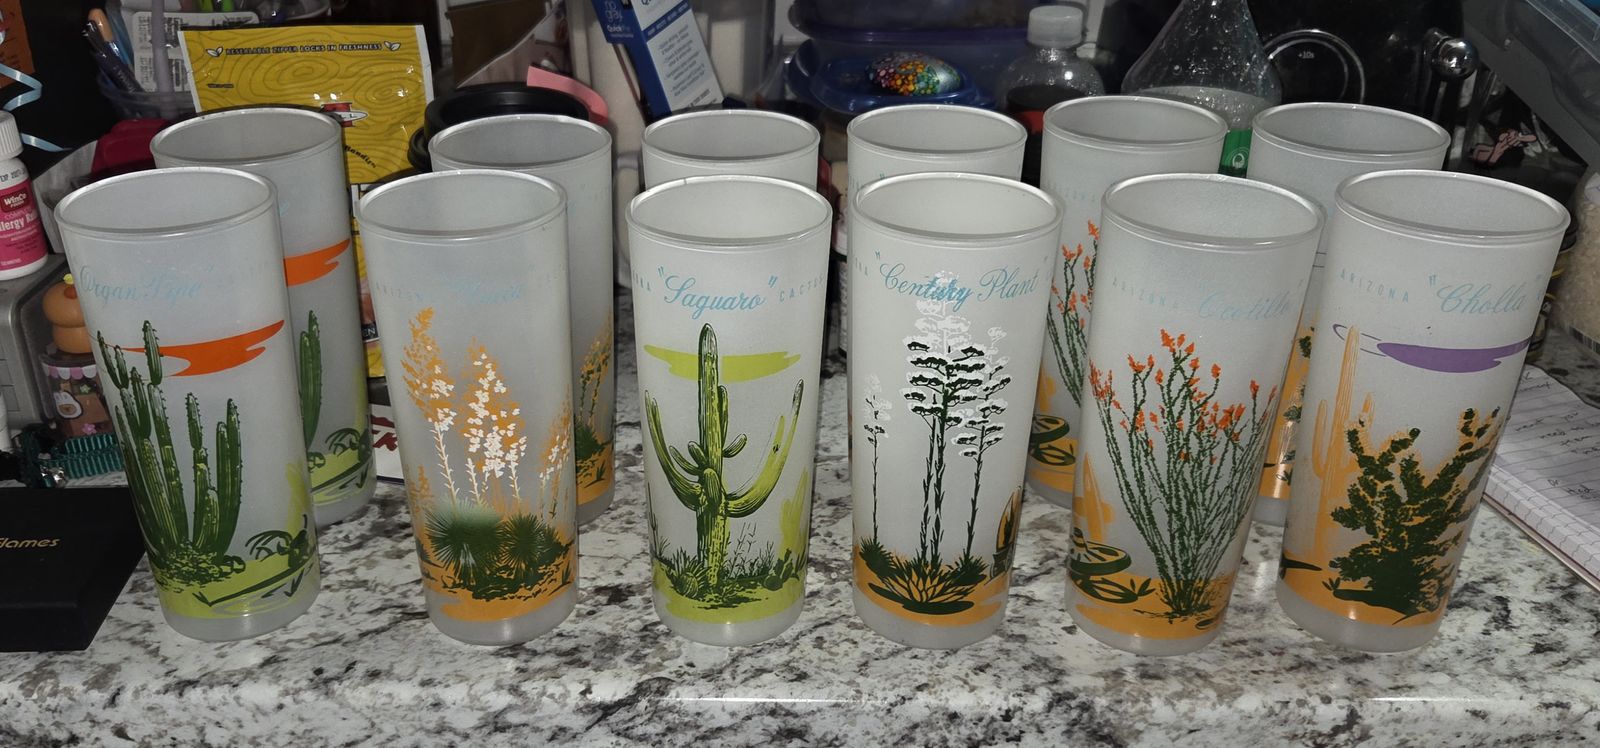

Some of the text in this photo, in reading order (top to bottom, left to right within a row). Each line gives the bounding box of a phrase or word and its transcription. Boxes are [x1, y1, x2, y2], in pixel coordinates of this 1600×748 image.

[272, 45, 298, 54] ZIPPER
[300, 44, 326, 53] LOCKS
[327, 44, 337, 52] IN
[339, 43, 383, 52] FRESHNESS
[3, 193, 27, 206] WinCo
[1340, 268, 1409, 303] ARIZONA
